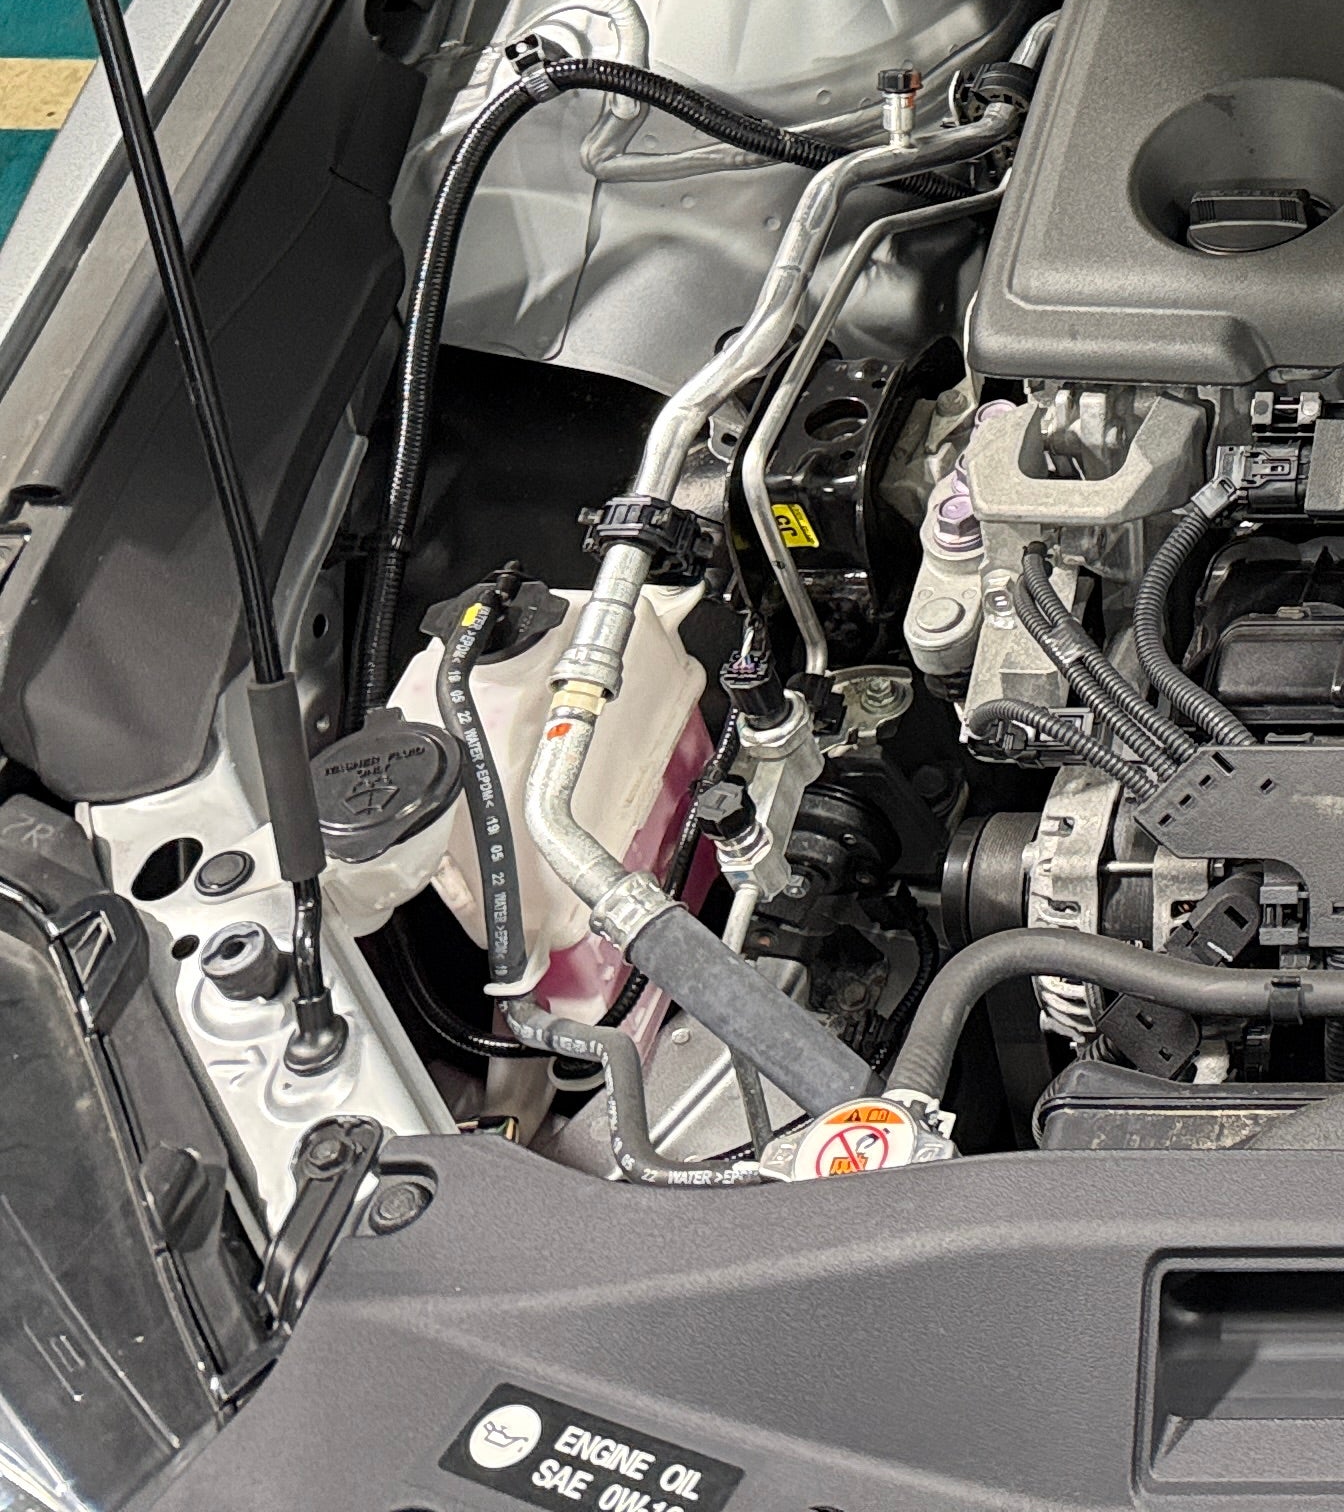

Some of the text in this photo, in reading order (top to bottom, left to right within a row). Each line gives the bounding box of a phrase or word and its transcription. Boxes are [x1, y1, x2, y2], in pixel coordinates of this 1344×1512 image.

[457, 710, 473, 725] 22
[463, 727, 485, 763] WATER
[490, 844, 505, 864] 05
[492, 872, 505, 887] 22
[640, 1168, 659, 1183] 22
[667, 1170, 713, 1186] WATER
[554, 1429, 702, 1501] ENGINE OIL
[531, 1458, 595, 1500] SAE
